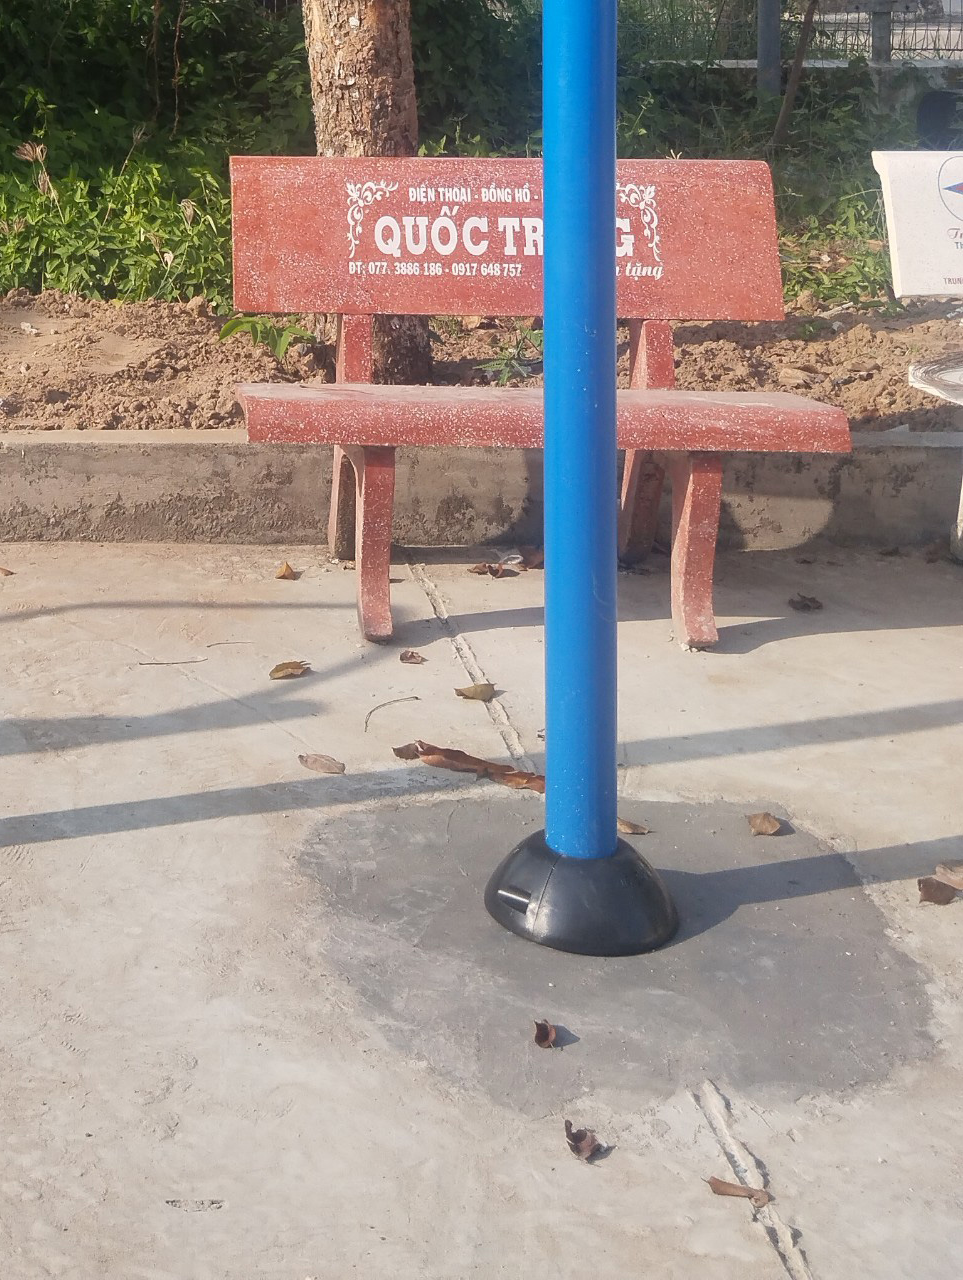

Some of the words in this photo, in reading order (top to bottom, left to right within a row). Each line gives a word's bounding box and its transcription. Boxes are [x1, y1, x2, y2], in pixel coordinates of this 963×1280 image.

[409, 185, 435, 205] ĐIỆN
[438, 188, 471, 205] THOẠI
[481, 183, 512, 203] ĐỒNG
[515, 184, 530, 202] HỒ
[374, 206, 489, 258] QUỐC
[395, 262, 420, 275] 3886
[424, 263, 442, 276] 186
[451, 263, 476, 276] 0917
[480, 263, 500, 276] 648
[503, 263, 522, 277] 757
[625, 261, 664, 280] tặng
